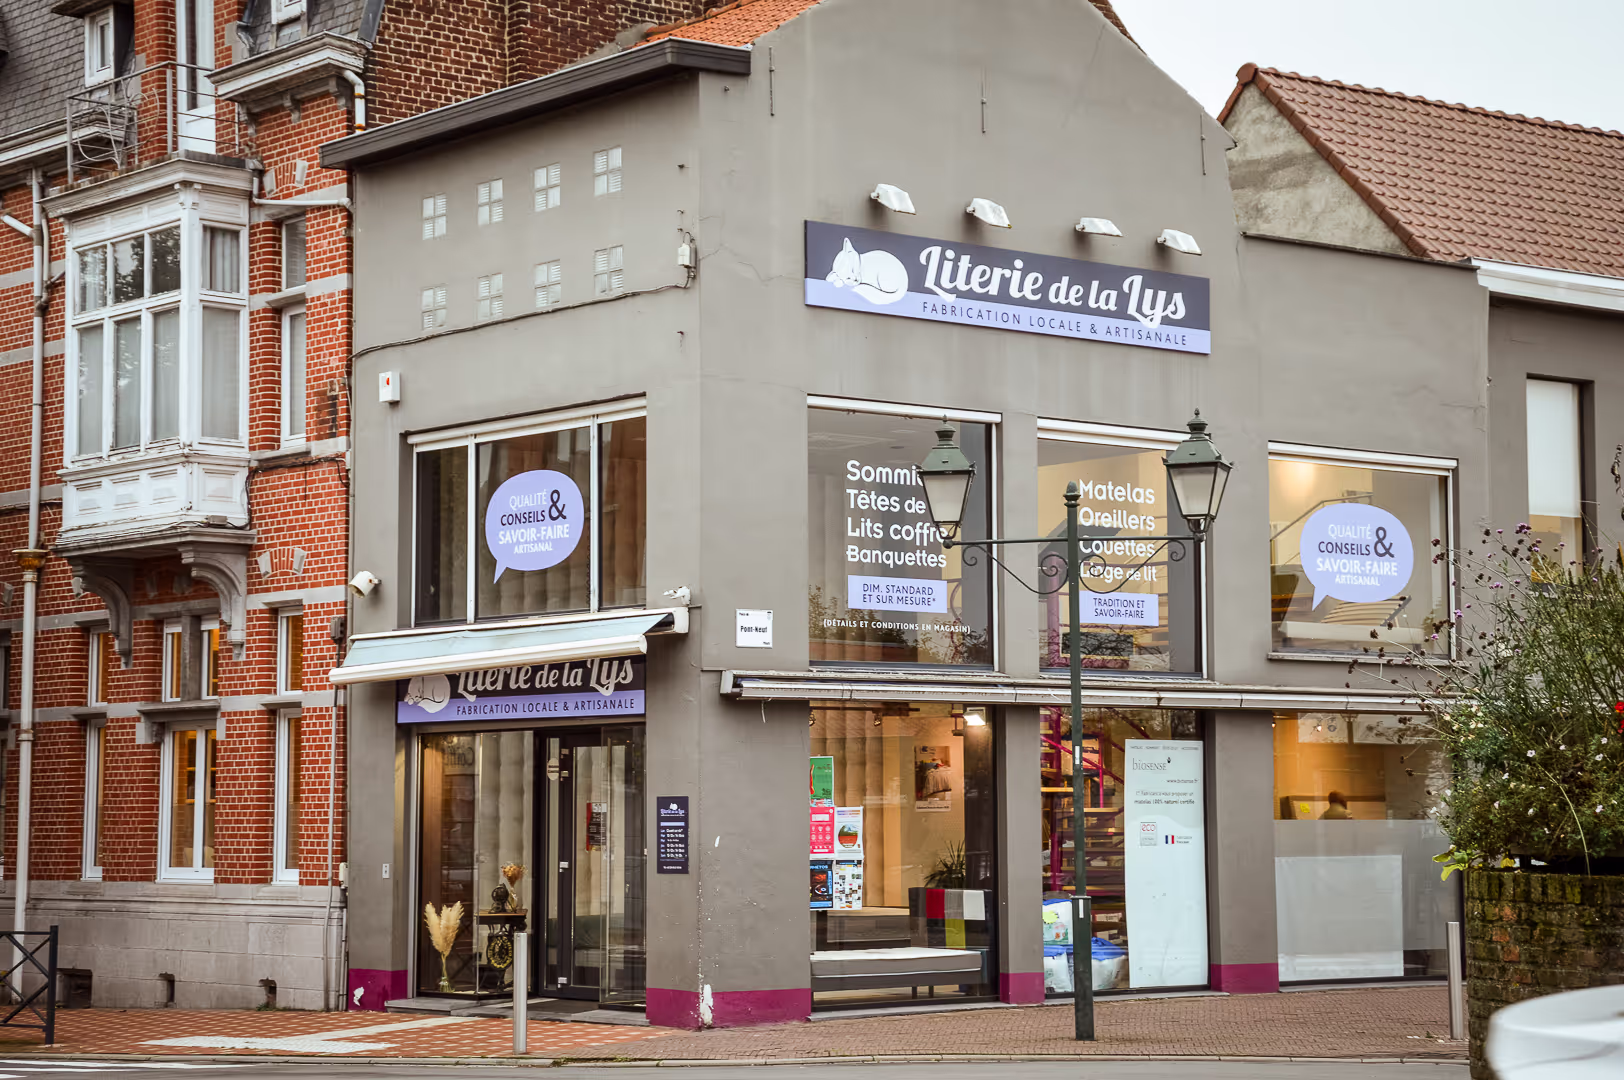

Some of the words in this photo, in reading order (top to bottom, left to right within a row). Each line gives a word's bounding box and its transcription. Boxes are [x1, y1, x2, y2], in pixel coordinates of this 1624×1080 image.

[919, 245, 1042, 302] Literie
[1048, 276, 1084, 306] de
[1089, 280, 1118, 311] la
[1122, 274, 1187, 329] Lys
[922, 301, 1022, 325] FABRICATION
[1029, 315, 1082, 333] LOCALE
[1089, 323, 1099, 335] &
[1105, 324, 1188, 346] ARTISANALE
[509, 489, 547, 511] QUALITÉ
[846, 489, 900, 512] Têtes
[904, 497, 926, 514] de
[1079, 479, 1155, 504] Matelas
[500, 510, 546, 526] CONSEILS
[548, 489, 567, 521] &
[847, 517, 884, 538] Lits
[1079, 507, 1155, 531] Oreillers
[498, 524, 570, 544] SAVOIR-FAIRE
[1318, 541, 1371, 556] CONSEILS
[1374, 526, 1395, 558] &
[1328, 524, 1372, 539] QUALITÉ
[513, 542, 553, 554] ARTISANAL
[846, 545, 947, 568] Banquettes
[1079, 536, 1155, 557] Couettes
[1080, 562, 1124, 583] Linge
[1126, 568, 1141, 581] de
[1143, 565, 1157, 582] lit
[1316, 558, 1398, 576] SAVOIR-FAIRE
[862, 583, 884, 593] DIM.
[885, 585, 934, 596] STANDARD
[1335, 575, 1380, 586] ARTISANAL
[862, 595, 873, 603] ET
[876, 595, 894, 604] SUR
[1093, 597, 1135, 608] TRADITION
[1136, 600, 1145, 609] ET
[1094, 608, 1145, 619] SAVOIR-FAIRE
[823, 618, 857, 628] (DÉTAILS
[859, 620, 870, 628] ET
[871, 620, 919, 631] CONDITIONS
[921, 623, 932, 631] EN
[934, 624, 971, 634] MAGASIN)
[535, 664, 559, 689] de
[562, 663, 583, 687] la
[586, 658, 633, 697] Lys
[456, 704, 518, 716] FABRICATION
[522, 701, 558, 713] LOCALE
[563, 701, 570, 711] &
[573, 698, 635, 711] ARTISANALE
